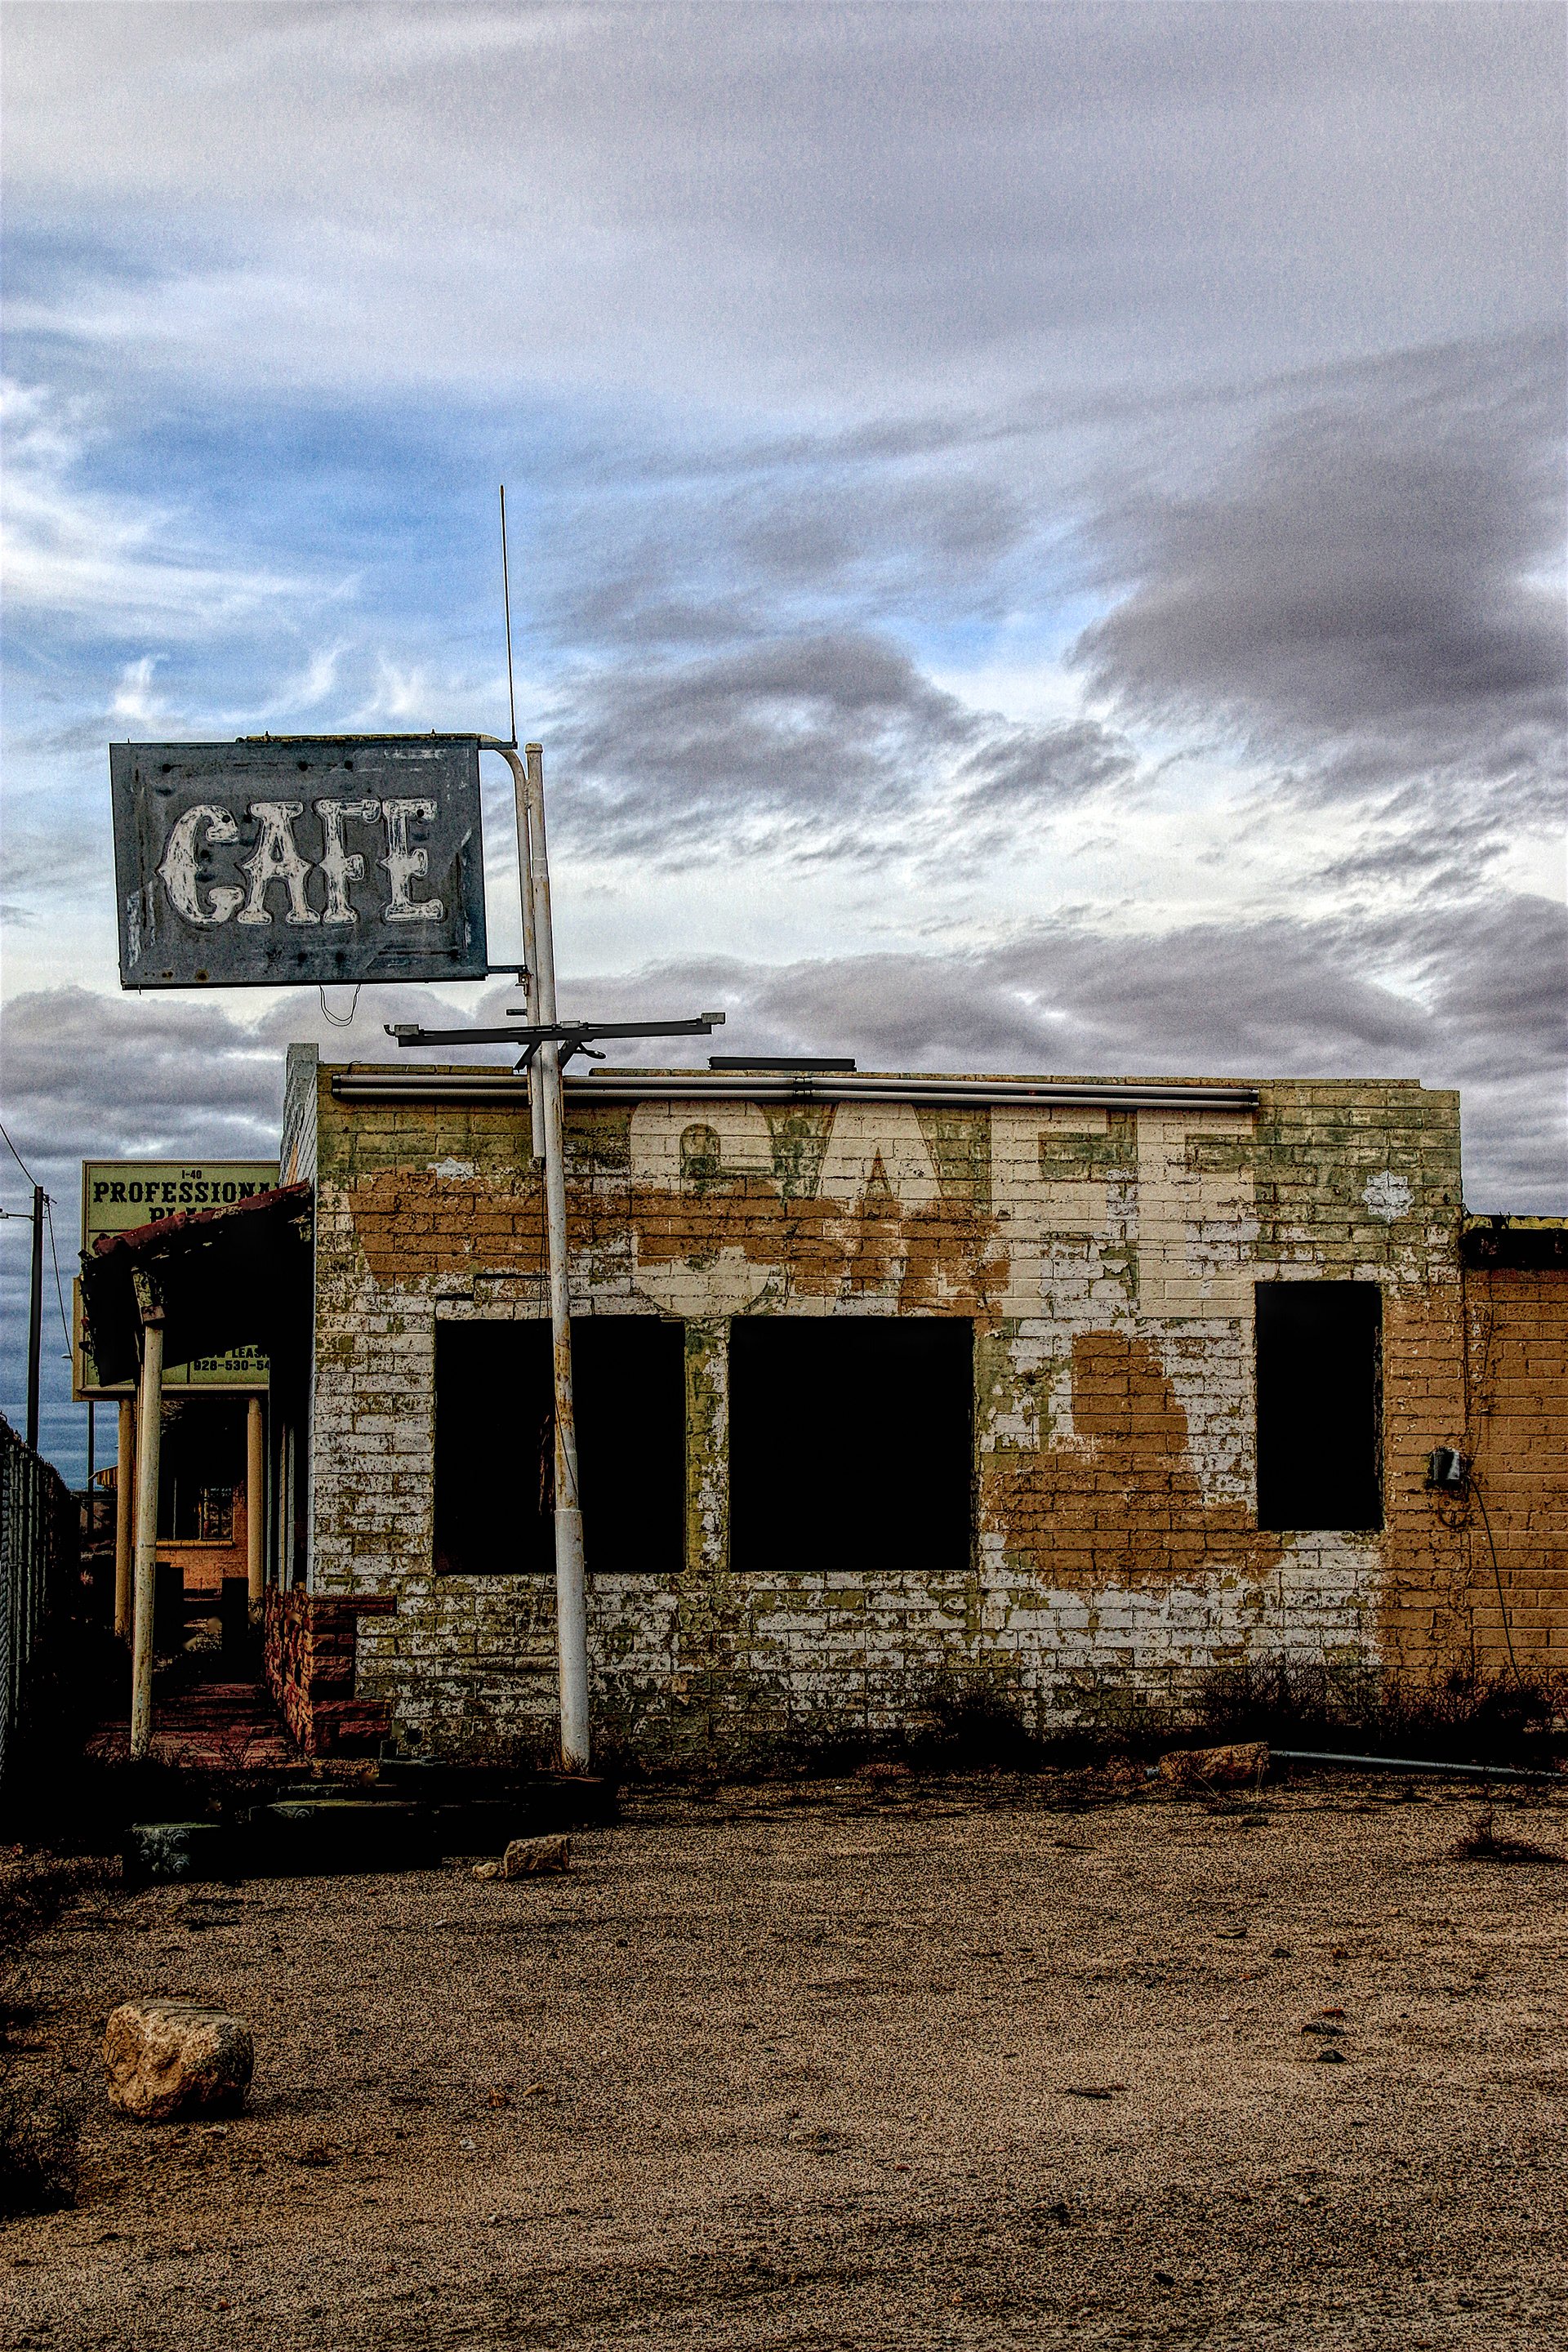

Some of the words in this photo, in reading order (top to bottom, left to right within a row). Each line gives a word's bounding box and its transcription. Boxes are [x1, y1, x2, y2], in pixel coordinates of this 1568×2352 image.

[158, 799, 445, 924] CAFE
[181, 1169, 202, 1179] I-40
[93, 1181, 280, 1203] PROFESSIONA
